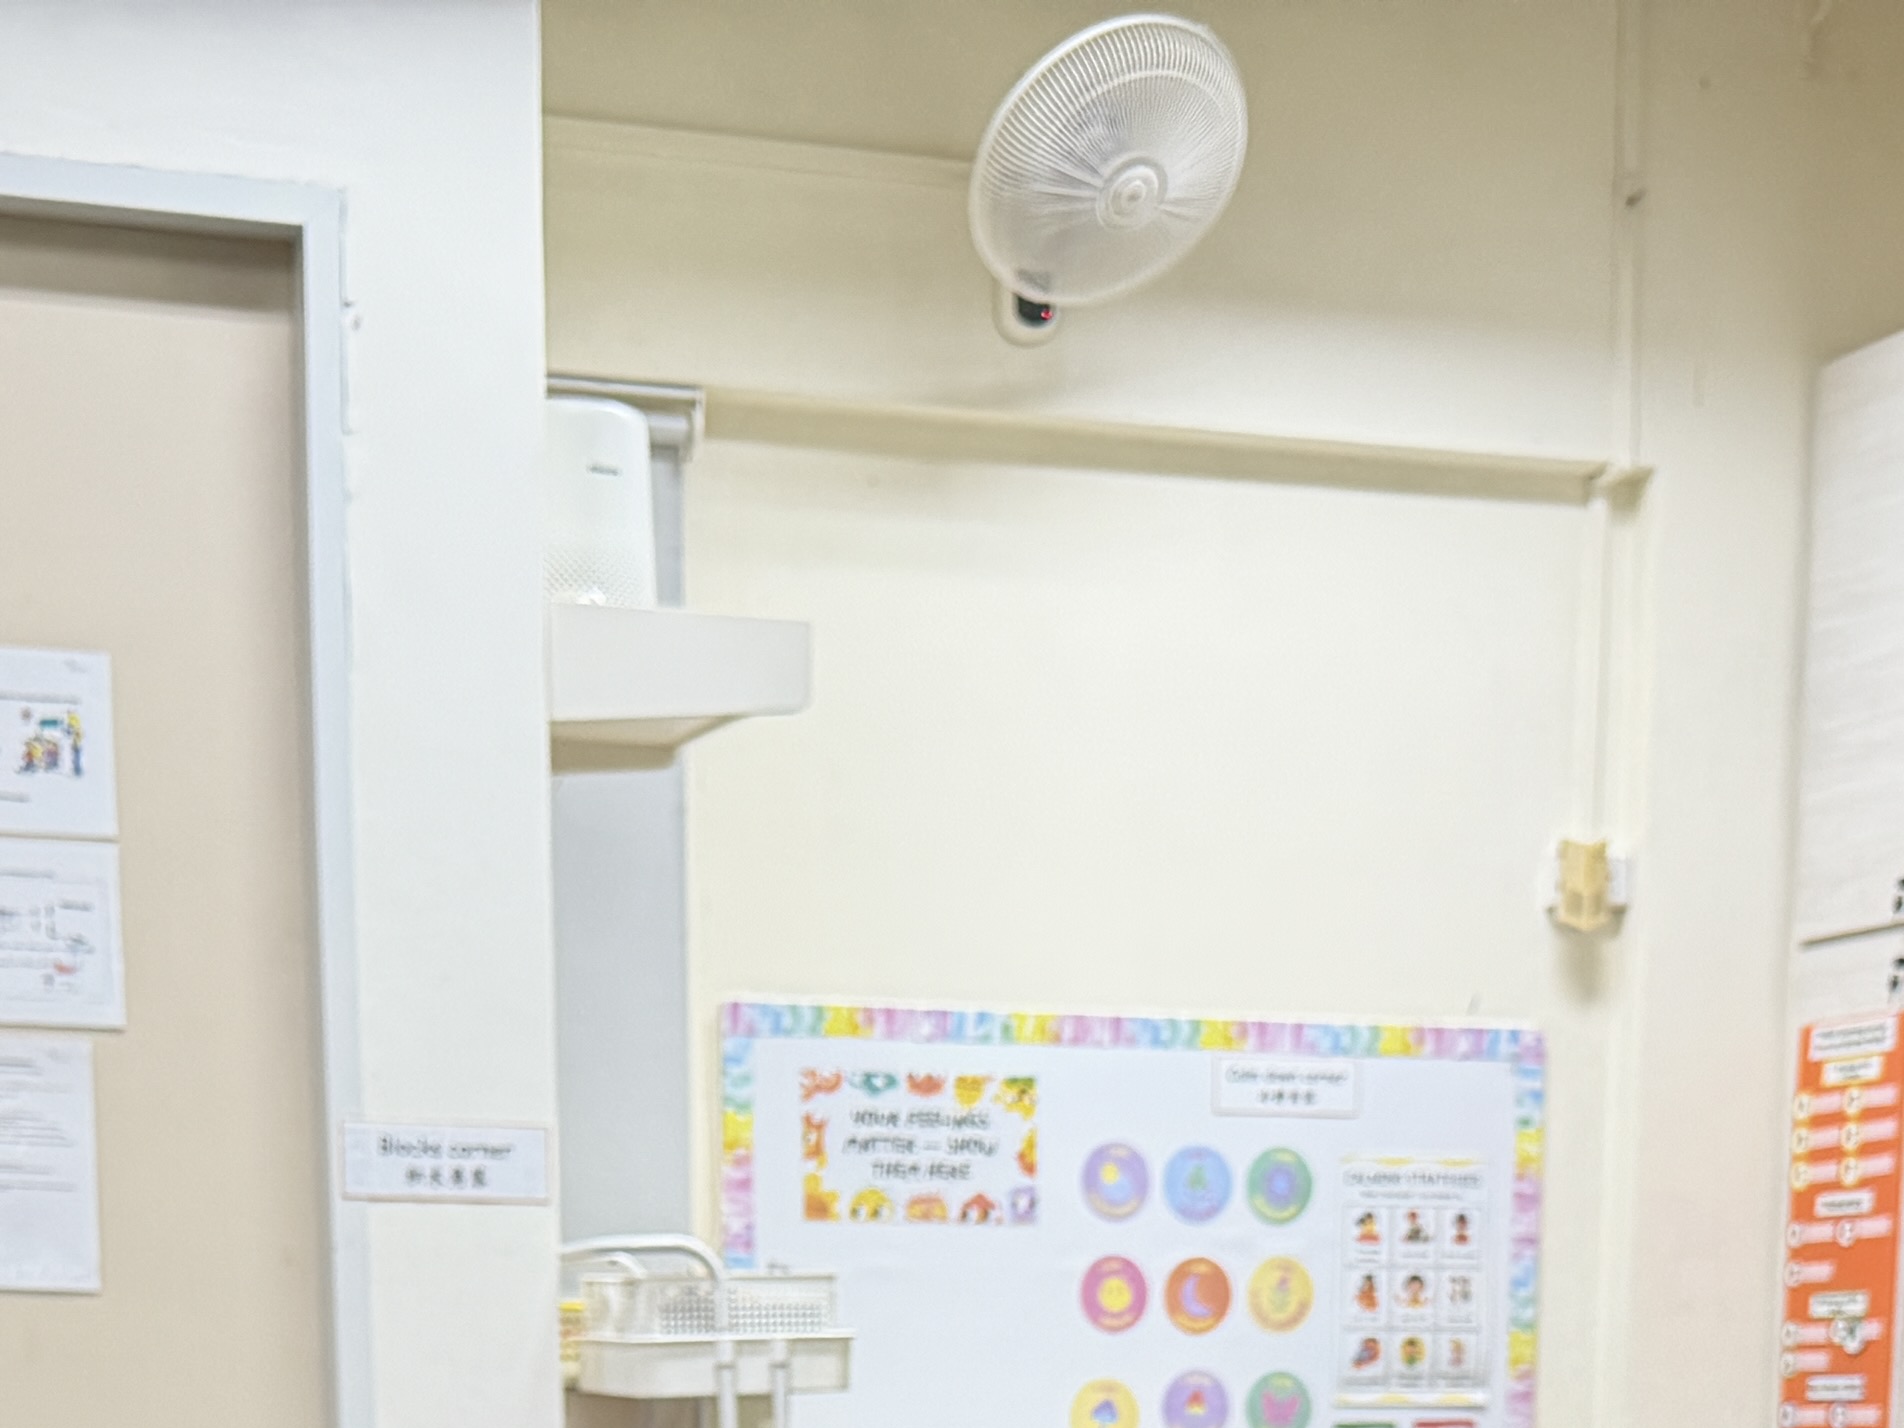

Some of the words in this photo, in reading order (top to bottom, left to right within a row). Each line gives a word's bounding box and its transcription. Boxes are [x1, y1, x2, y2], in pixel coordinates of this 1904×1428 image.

[851, 1110, 900, 1129] YOUR
[905, 1110, 991, 1130] FEELINGS
[446, 1144, 515, 1162] corner
[842, 1134, 916, 1155] MATTER
[947, 1135, 999, 1158] SHOW
[872, 1161, 921, 1179] THEM
[924, 1161, 972, 1180] HERE
